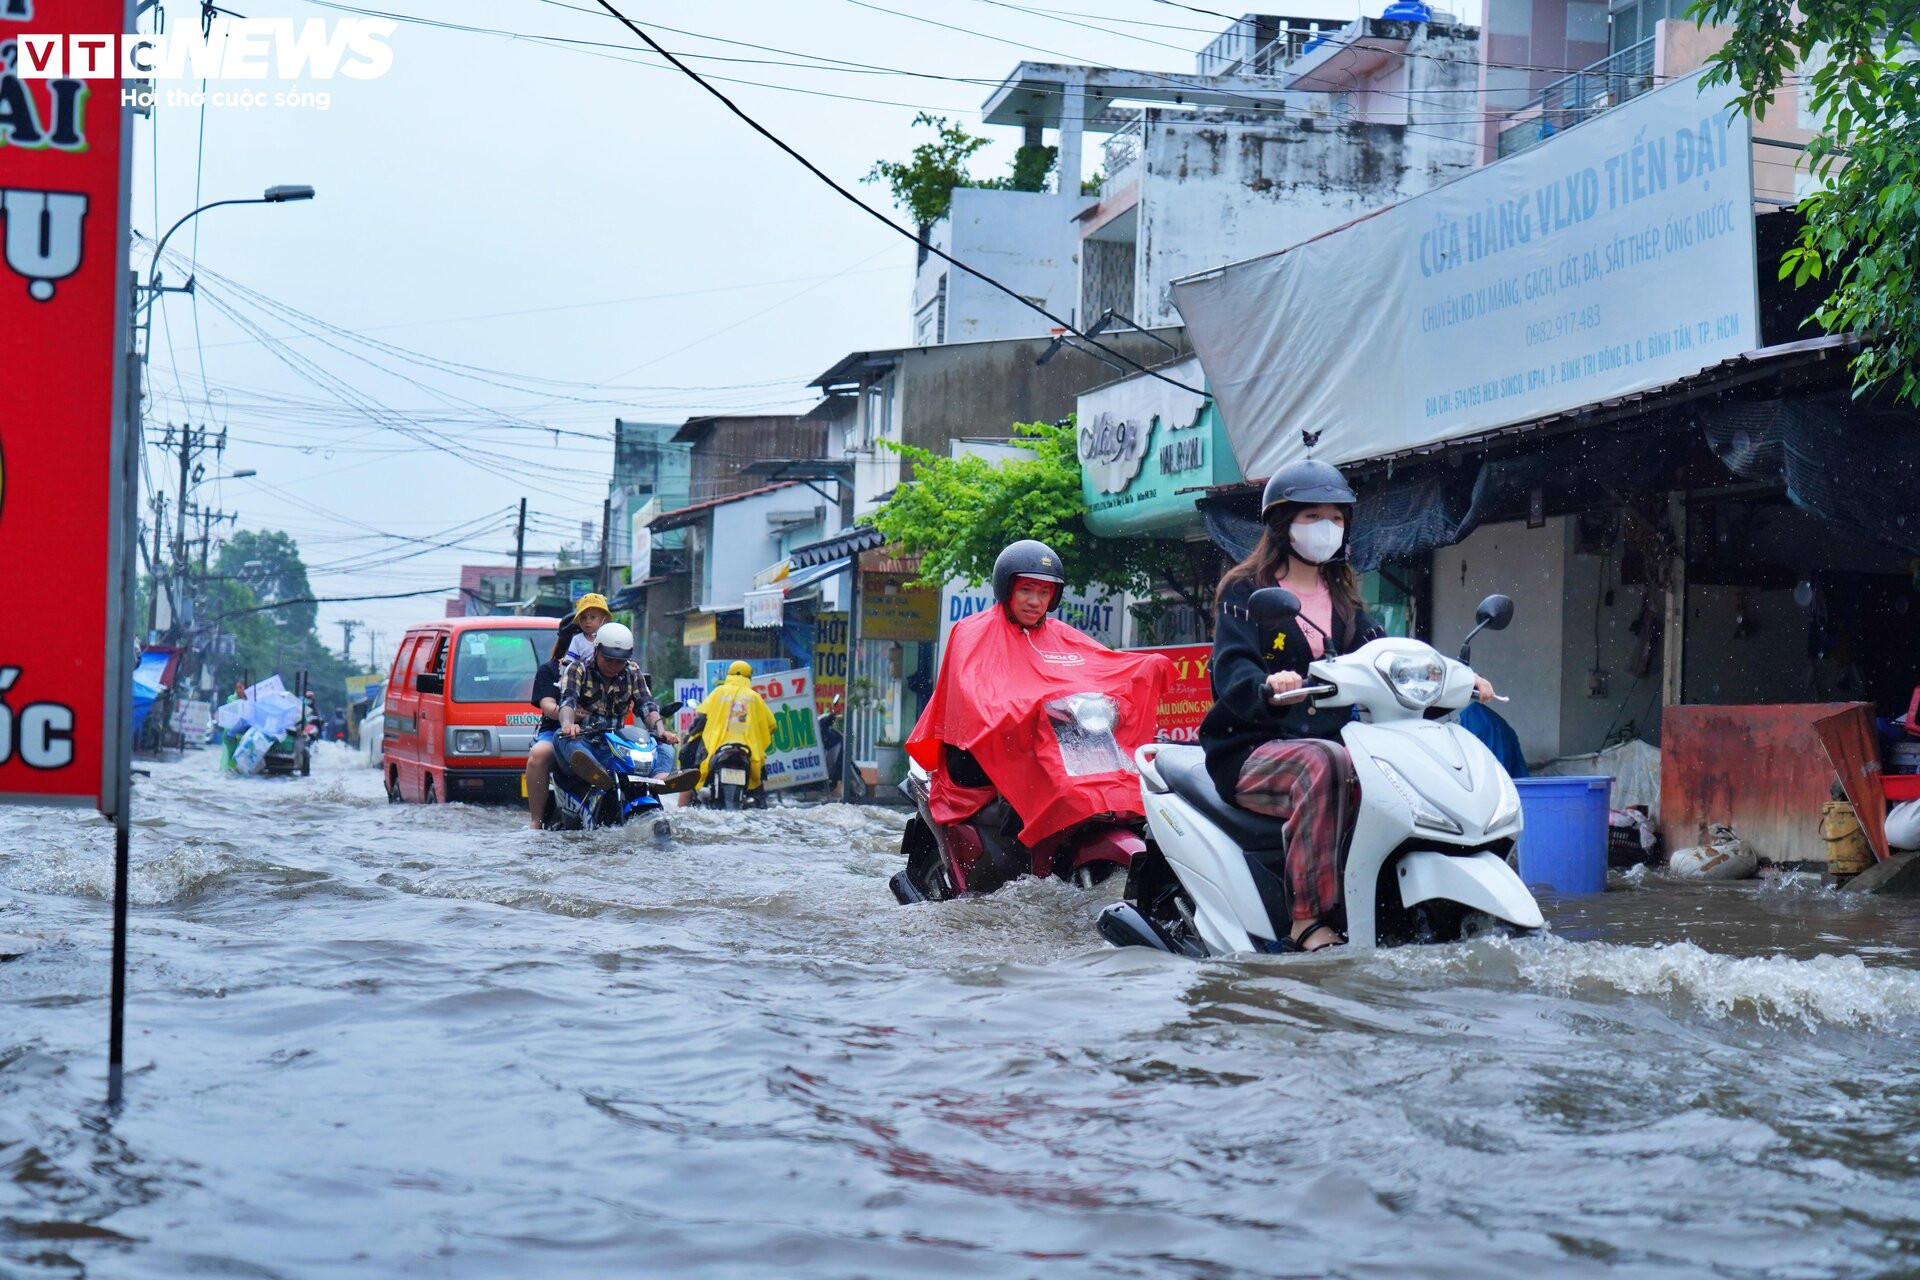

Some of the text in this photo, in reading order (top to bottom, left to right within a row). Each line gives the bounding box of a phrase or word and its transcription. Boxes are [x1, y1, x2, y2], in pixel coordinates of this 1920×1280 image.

[1466, 194, 1531, 263] HÀNG
[1535, 167, 1599, 237] VLXD
[1603, 124, 1668, 210] TIẾN
[1673, 109, 1732, 192] ĐẠT
[1460, 292, 1474, 321] KD
[1476, 287, 1486, 317] XI
[1524, 265, 1556, 305] GẠCH,
[1558, 252, 1581, 289] CÁT,
[1583, 243, 1603, 282] ĐÁ,
[1627, 223, 1662, 266] THÉP,
[1664, 212, 1694, 254] ỐNG
[1696, 197, 1735, 244] NƯỚC
[1525, 303, 1601, 347] 0982.917.483
[1551, 364, 1559, 385] P.
[1561, 356, 1581, 383] BÌNH
[1582, 351, 1597, 379] TRỊ
[1636, 339, 1646, 363] Q.
[1649, 330, 1671, 360] BÌNH
[1697, 320, 1714, 345] TP.
[1716, 312, 1740, 342] HCM
[791, 677, 806, 695] 7
[816, 646, 847, 677] TÓC
[765, 703, 817, 756] ƠM
